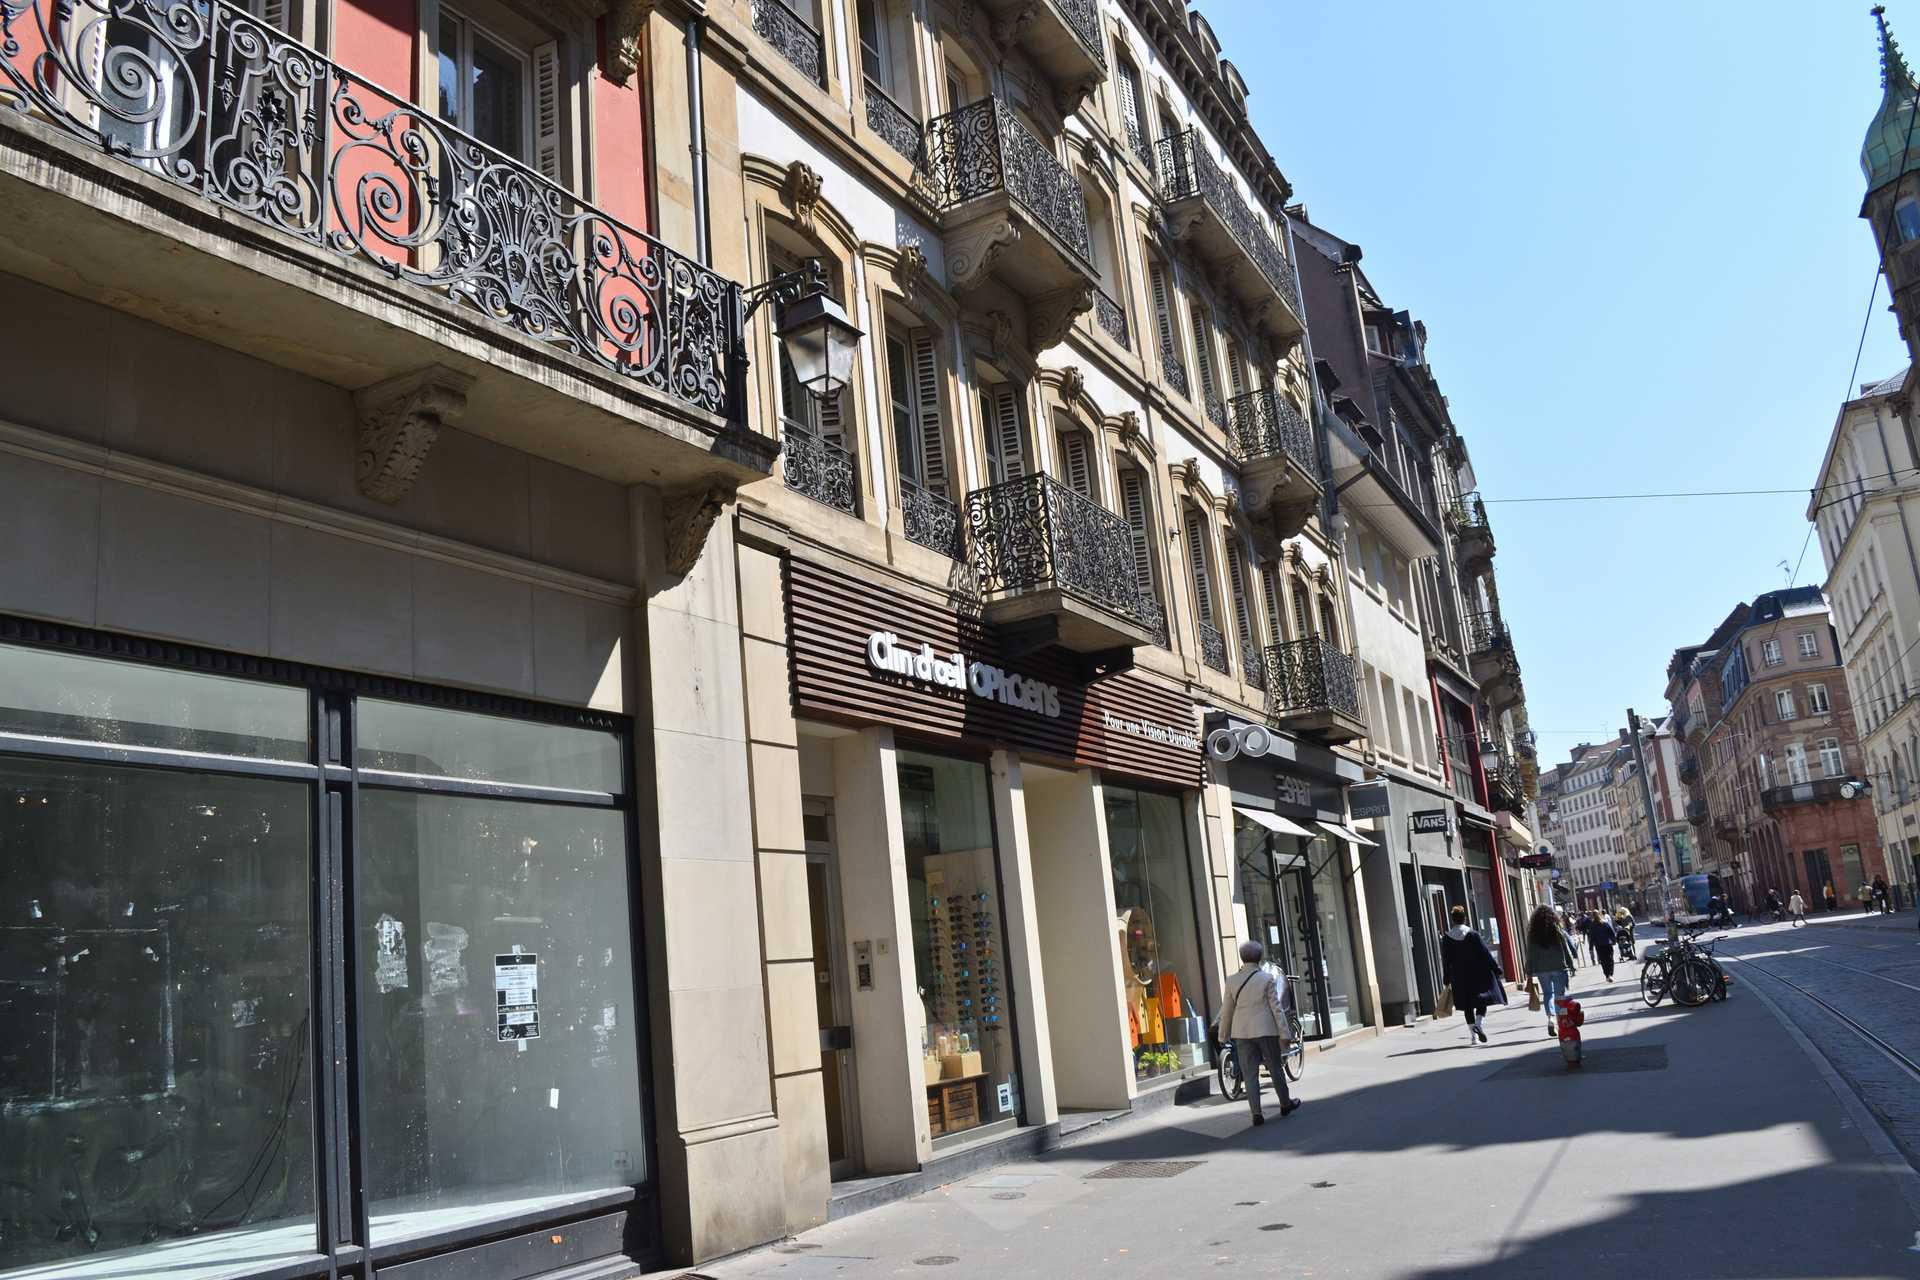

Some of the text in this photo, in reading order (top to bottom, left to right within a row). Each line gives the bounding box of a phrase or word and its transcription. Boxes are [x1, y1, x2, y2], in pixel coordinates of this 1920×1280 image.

[1104, 711, 1198, 749] Pour une Vision Durable
[1353, 804, 1387, 817] ESPRIT
